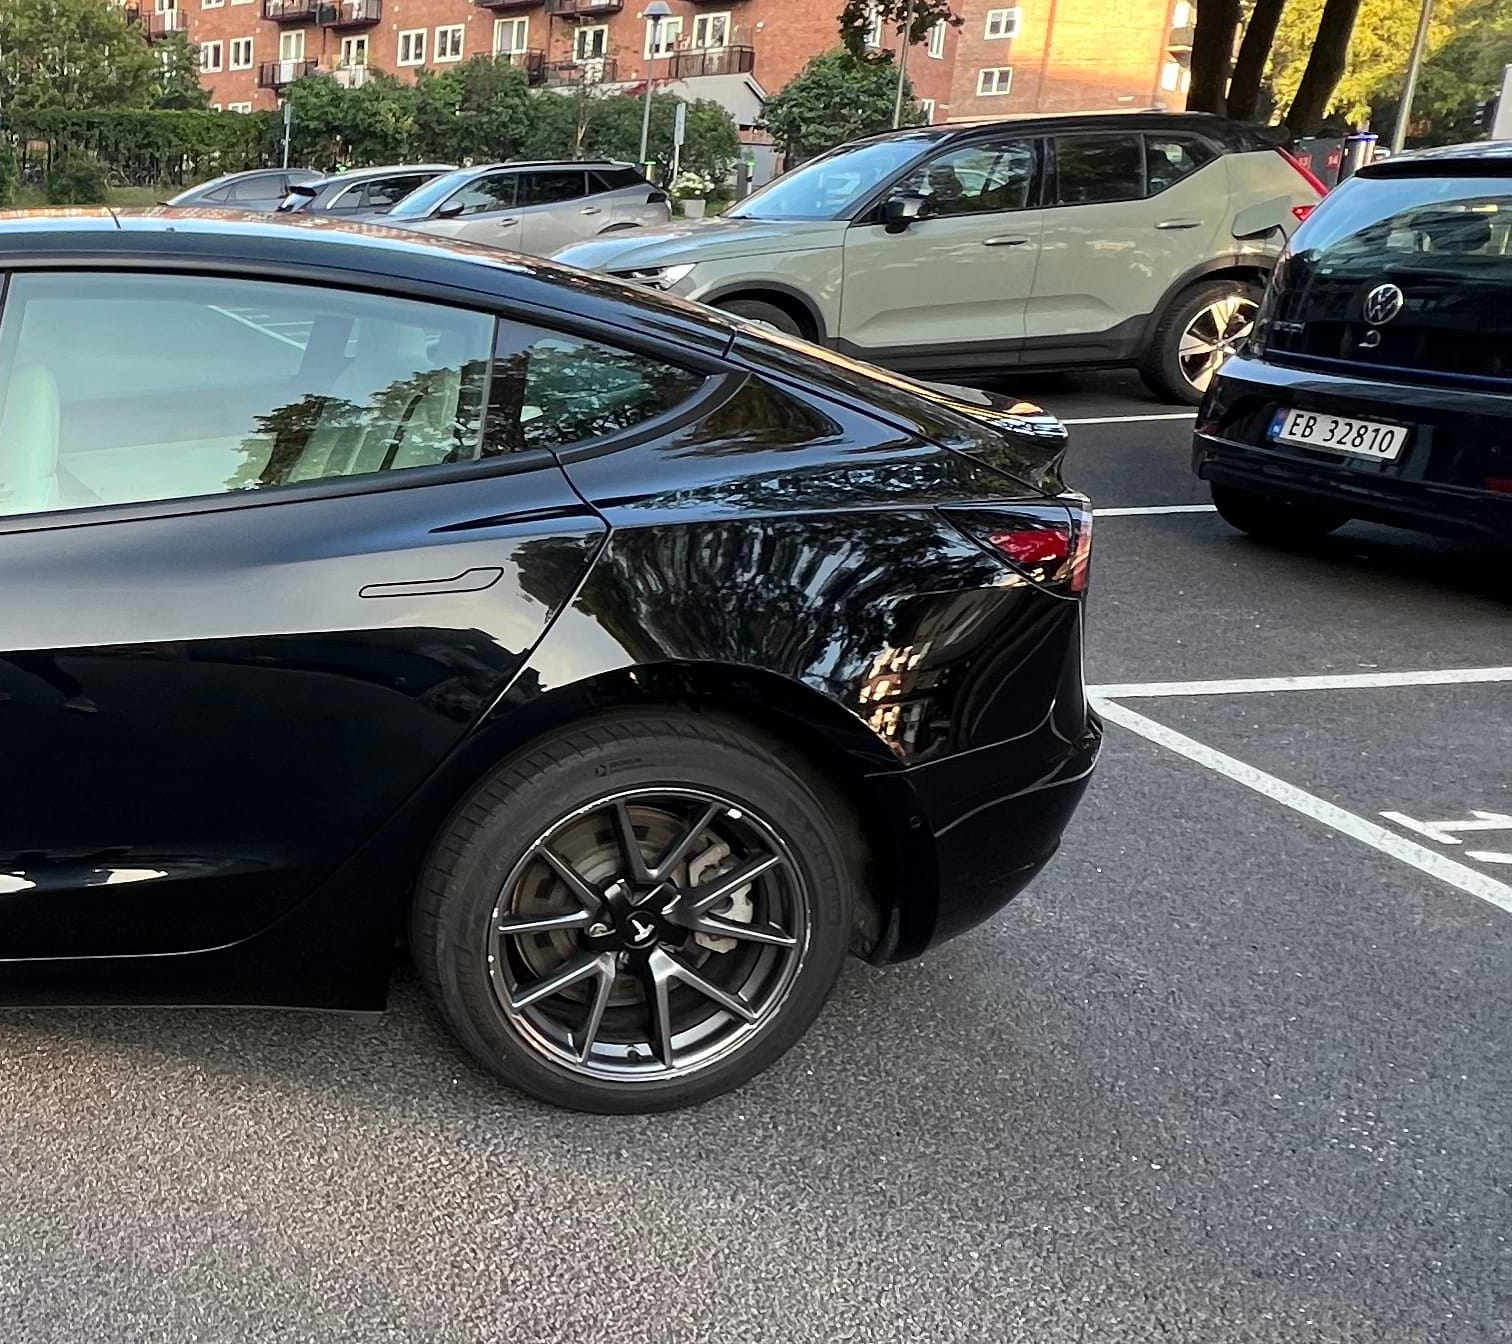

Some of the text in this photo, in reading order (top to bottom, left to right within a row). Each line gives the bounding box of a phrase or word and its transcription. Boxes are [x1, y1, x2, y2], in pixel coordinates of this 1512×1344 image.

[1364, 285, 1403, 324] VW
[1288, 413, 1395, 453] EB 32810
